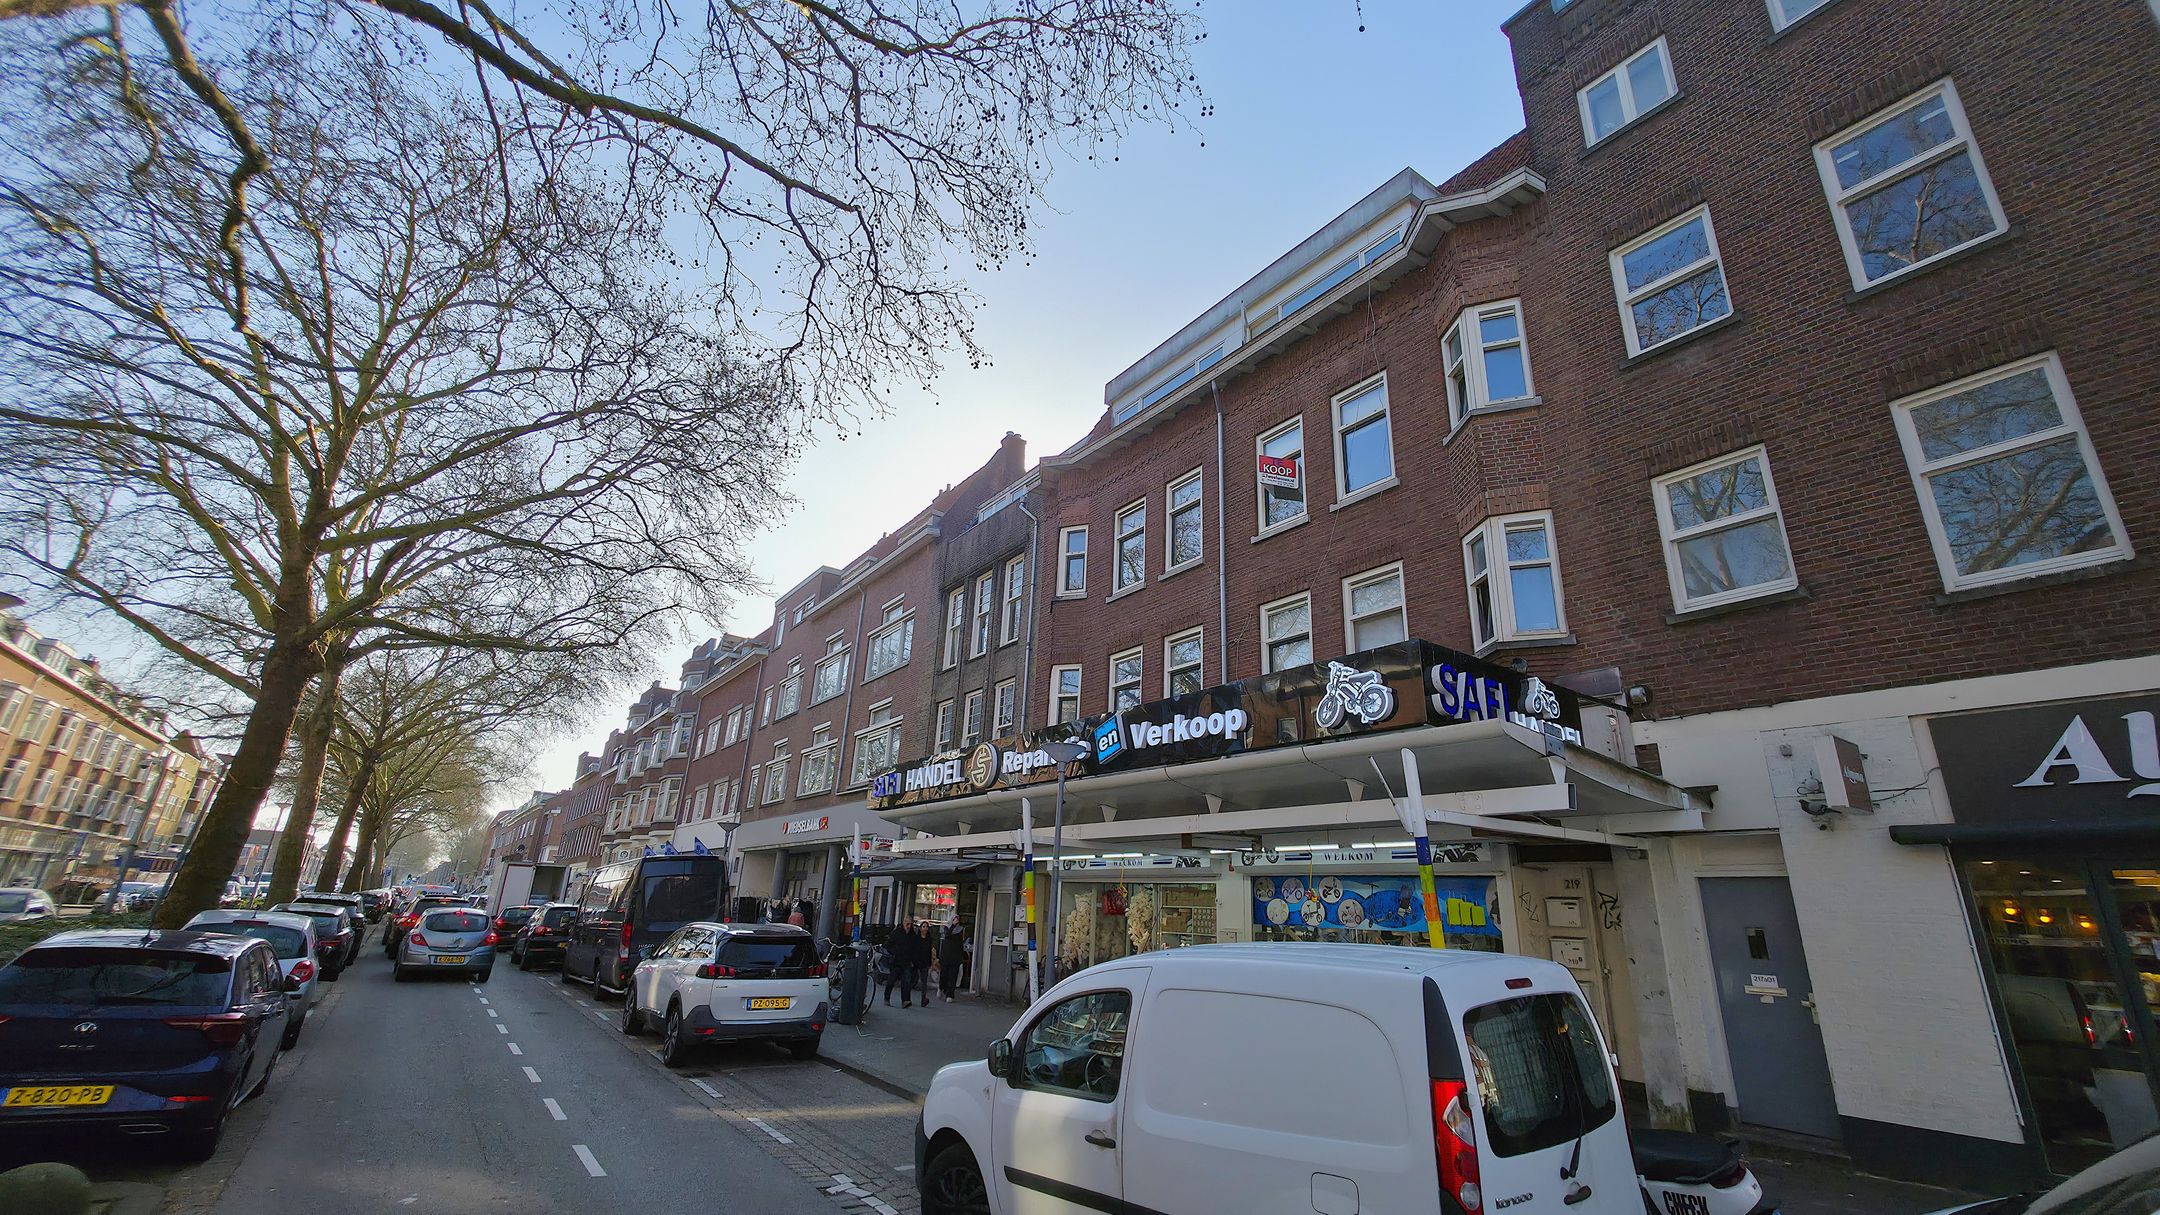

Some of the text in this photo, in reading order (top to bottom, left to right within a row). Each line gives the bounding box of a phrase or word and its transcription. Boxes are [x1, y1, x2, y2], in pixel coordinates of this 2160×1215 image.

[1263, 463, 1293, 476] KOOP
[905, 760, 965, 792] HANDEL
[1098, 730, 1118, 751] en
[1130, 708, 1247, 749] Verkoop
[1324, 852, 1374, 861] WELKOM
[1565, 879, 1581, 889] 219
[743, 999, 788, 1008] PZ-095-G
[9, 1087, 105, 1105] Z-820-PB
